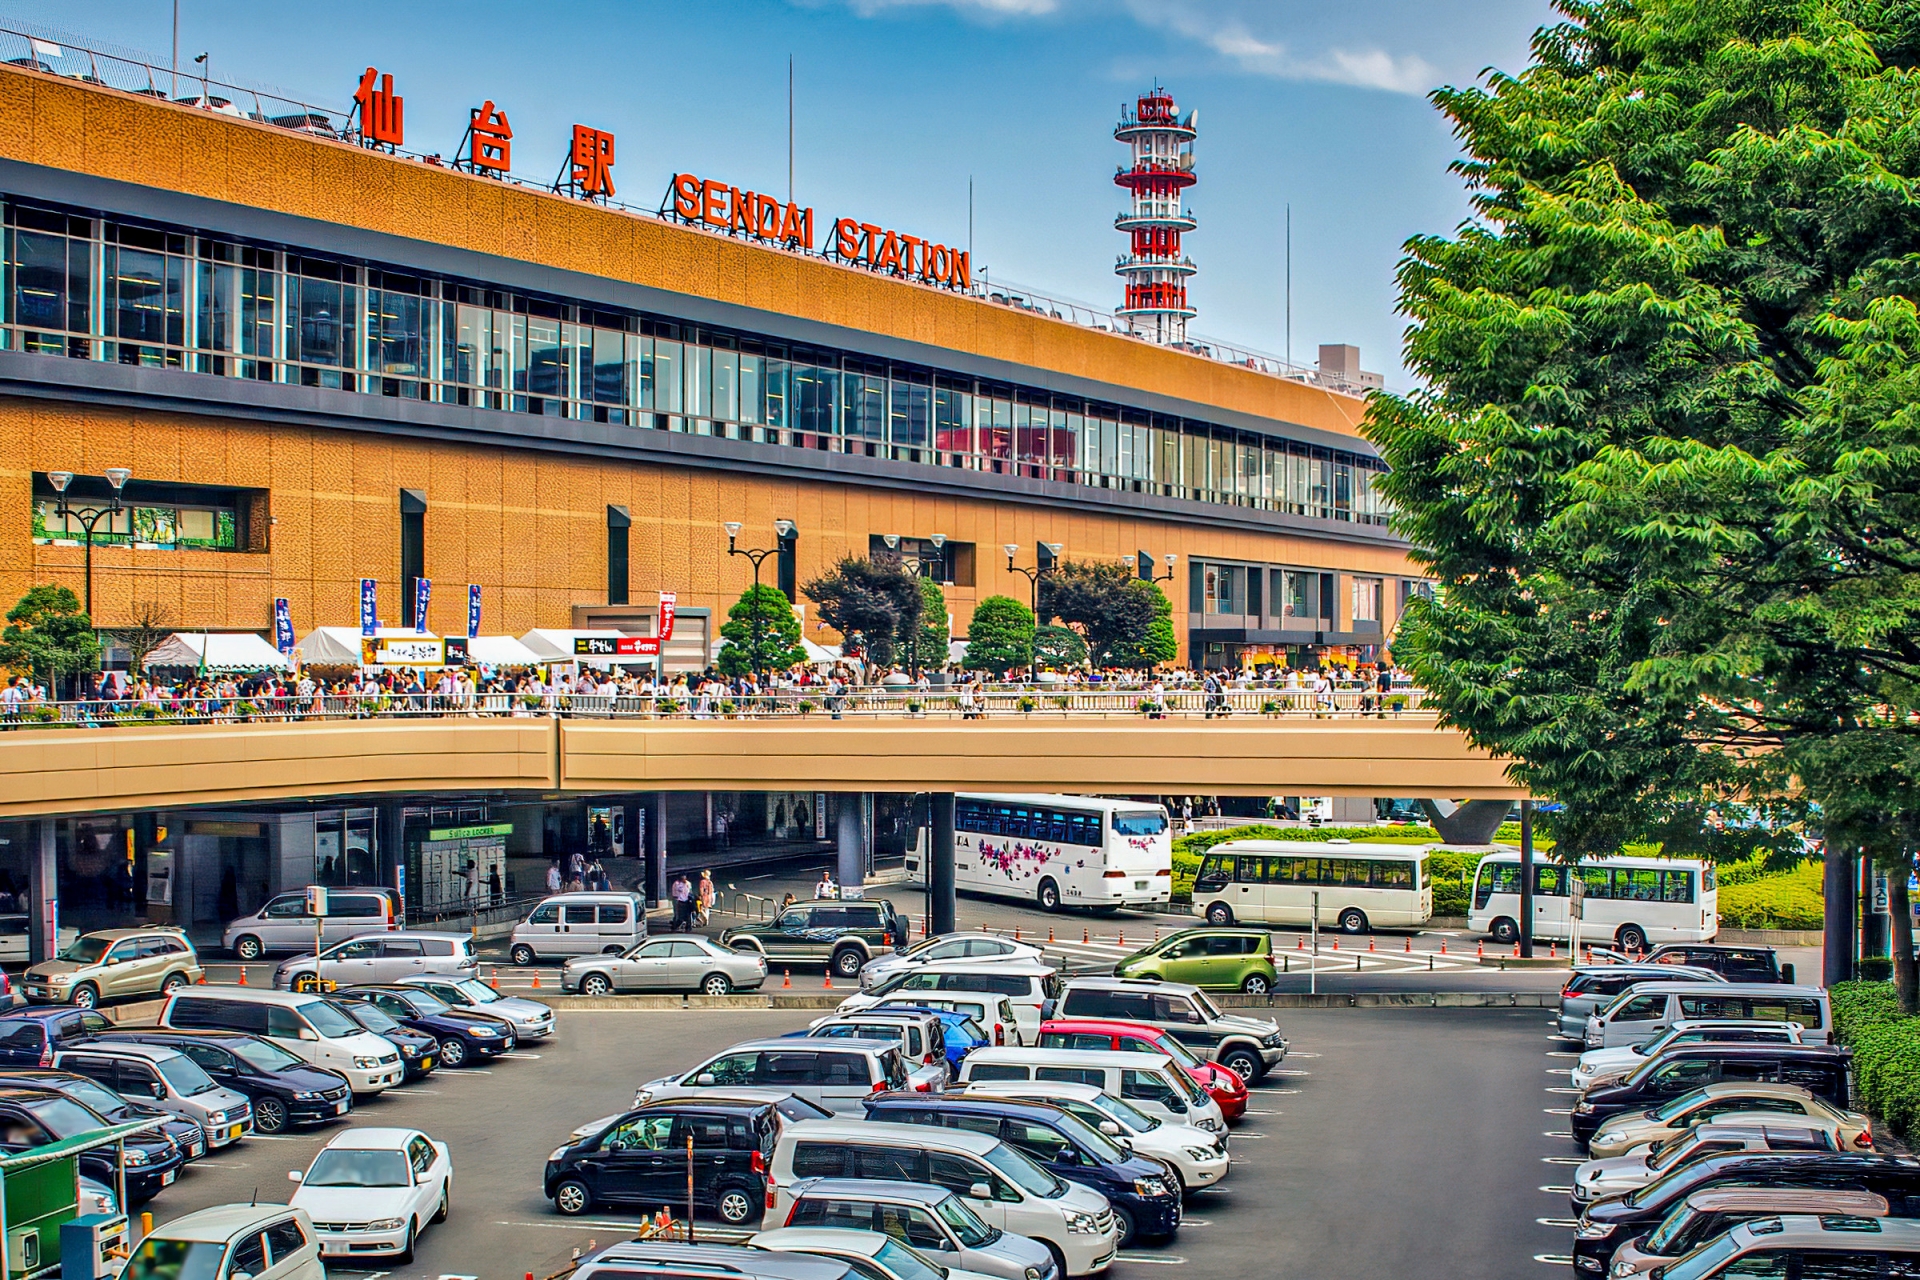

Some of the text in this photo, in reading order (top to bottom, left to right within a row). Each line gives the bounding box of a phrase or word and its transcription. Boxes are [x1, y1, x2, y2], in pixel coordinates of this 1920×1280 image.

[353, 67, 616, 197] 仙台駅
[675, 173, 971, 289] SENDAI STATION
